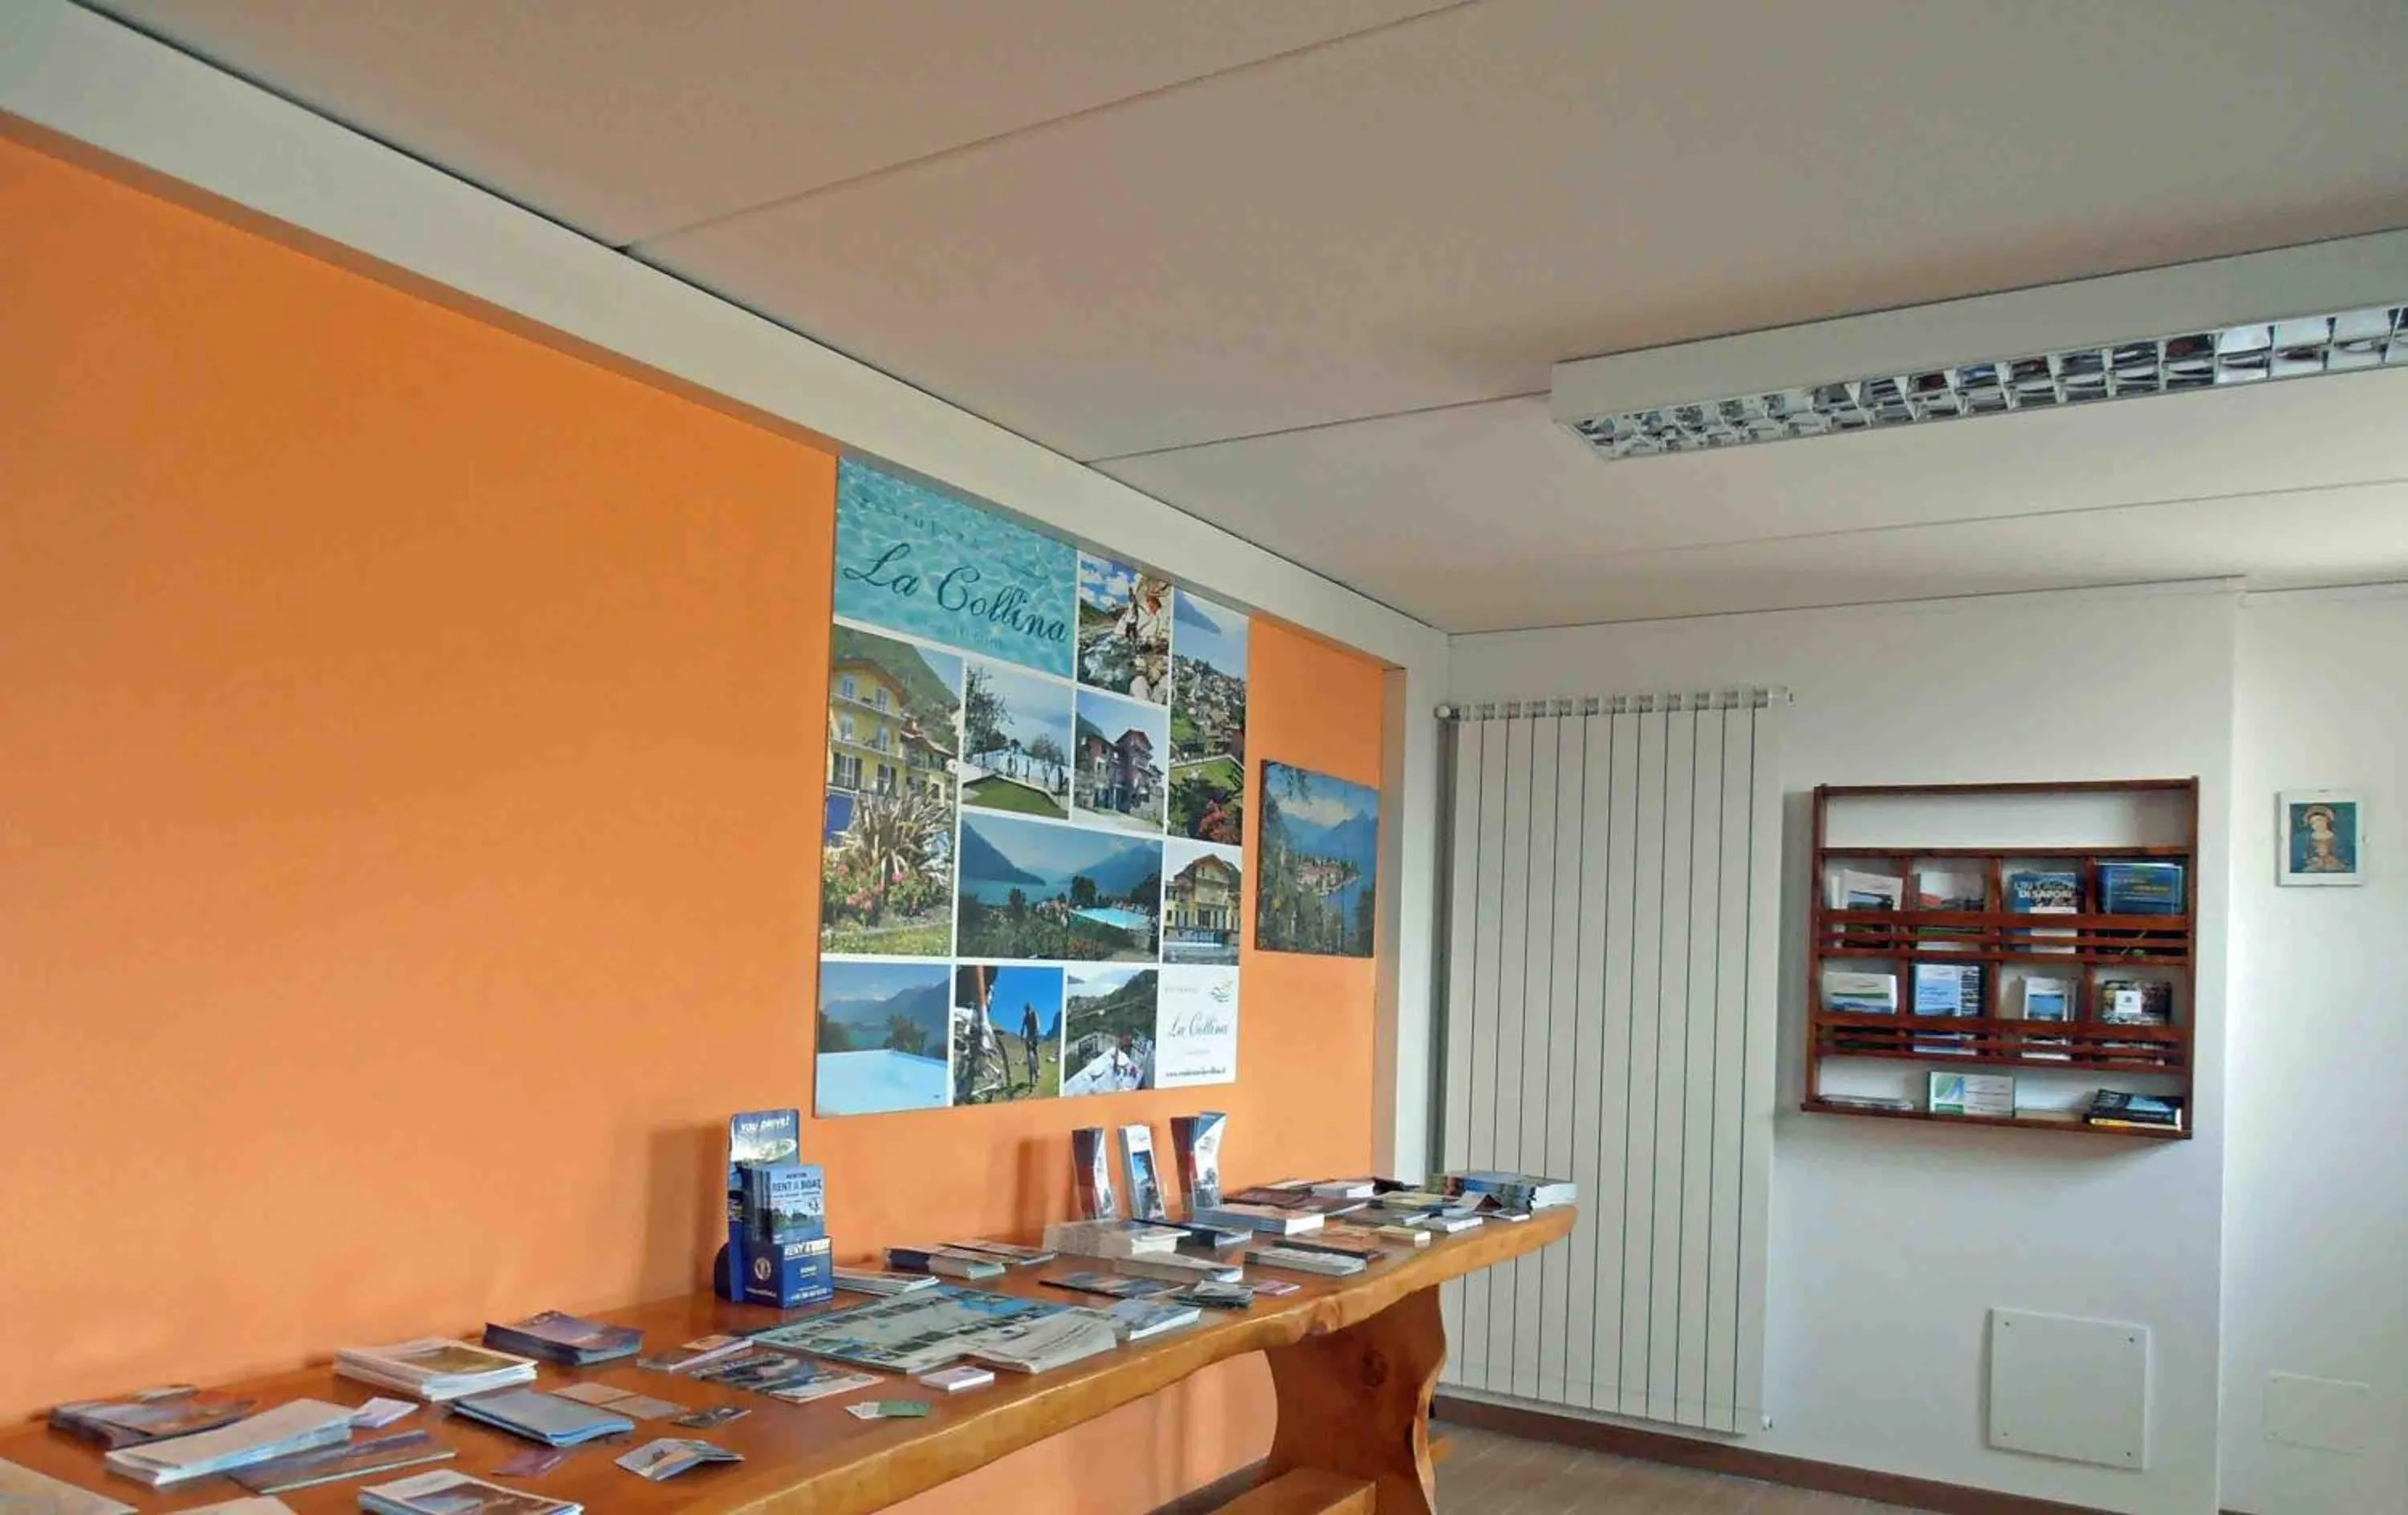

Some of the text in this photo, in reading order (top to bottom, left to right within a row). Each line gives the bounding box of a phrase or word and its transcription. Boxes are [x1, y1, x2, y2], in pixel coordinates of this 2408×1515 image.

[844, 542, 1067, 643] La Collina
[1189, 1011, 1229, 1038] Collina
